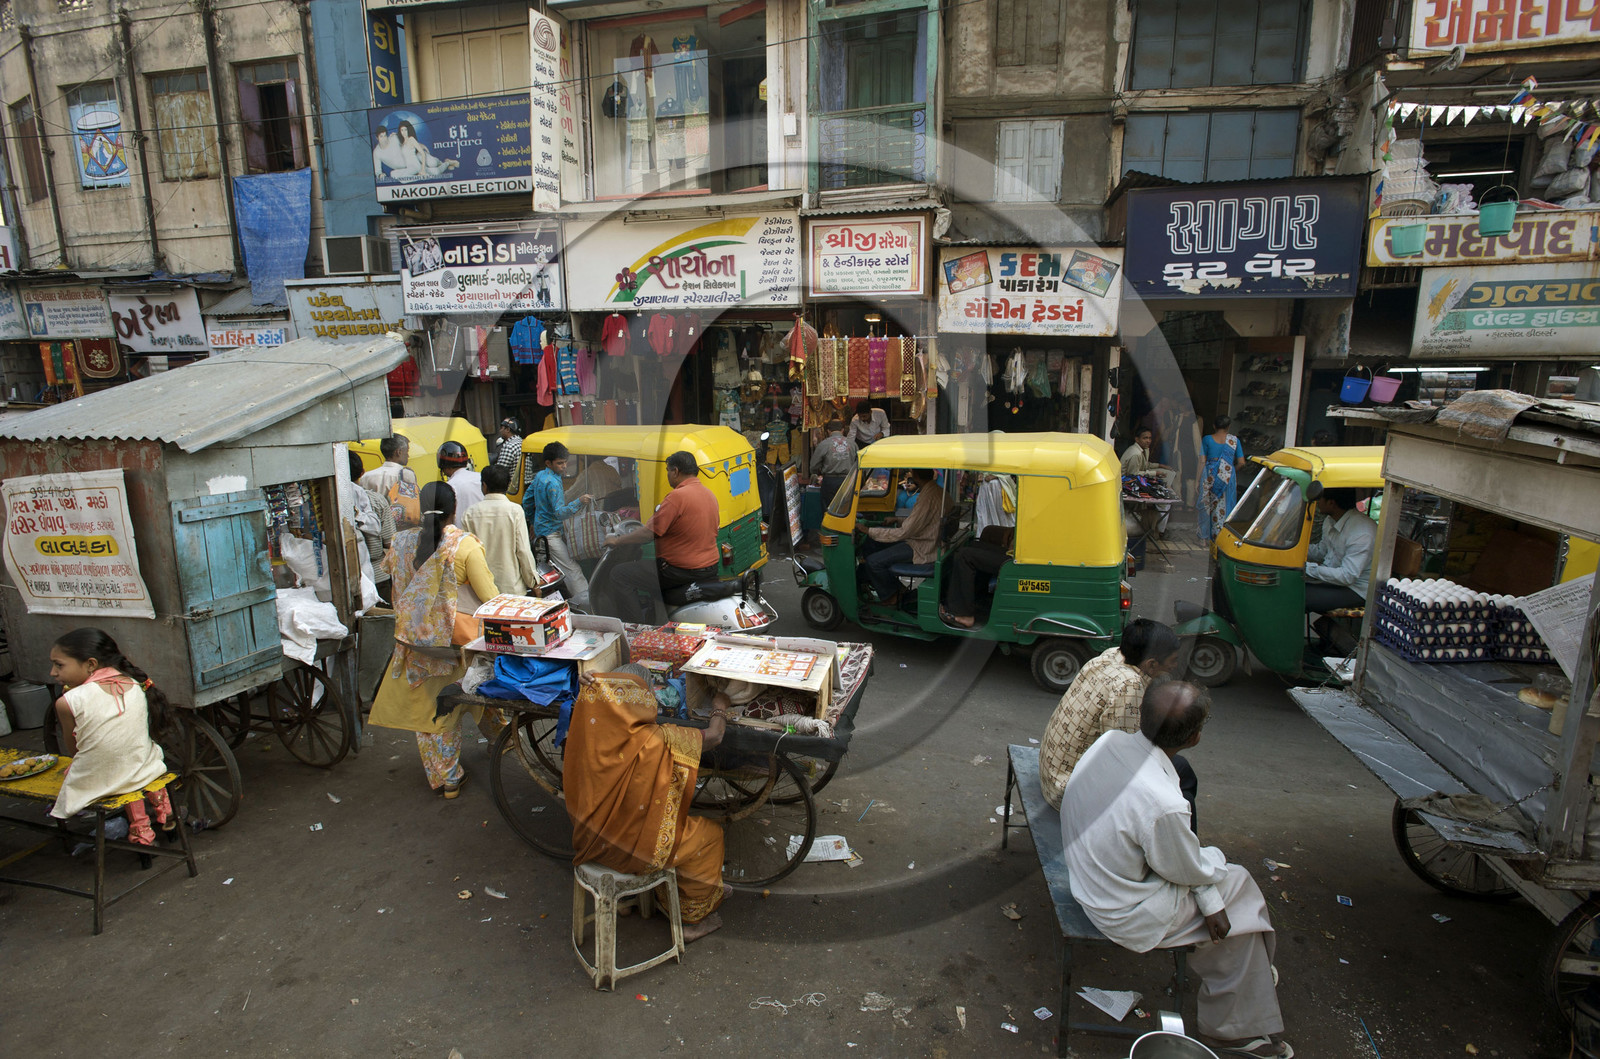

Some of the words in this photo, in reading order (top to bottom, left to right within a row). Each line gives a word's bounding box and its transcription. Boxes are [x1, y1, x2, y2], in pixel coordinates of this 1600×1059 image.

[433, 138, 482, 159] marjara
[391, 185, 447, 199] NAKODA
[450, 179, 528, 194] SELECTION
[444, 235, 517, 265] નાકોડા
[825, 227, 877, 252] શ્રીજી
[879, 230, 908, 250] સરૈયા
[648, 245, 736, 290] શાયોના
[1000, 253, 1062, 277] કદમ
[682, 280, 701, 291] ફેશન
[1030, 582, 1050, 592] 5455
